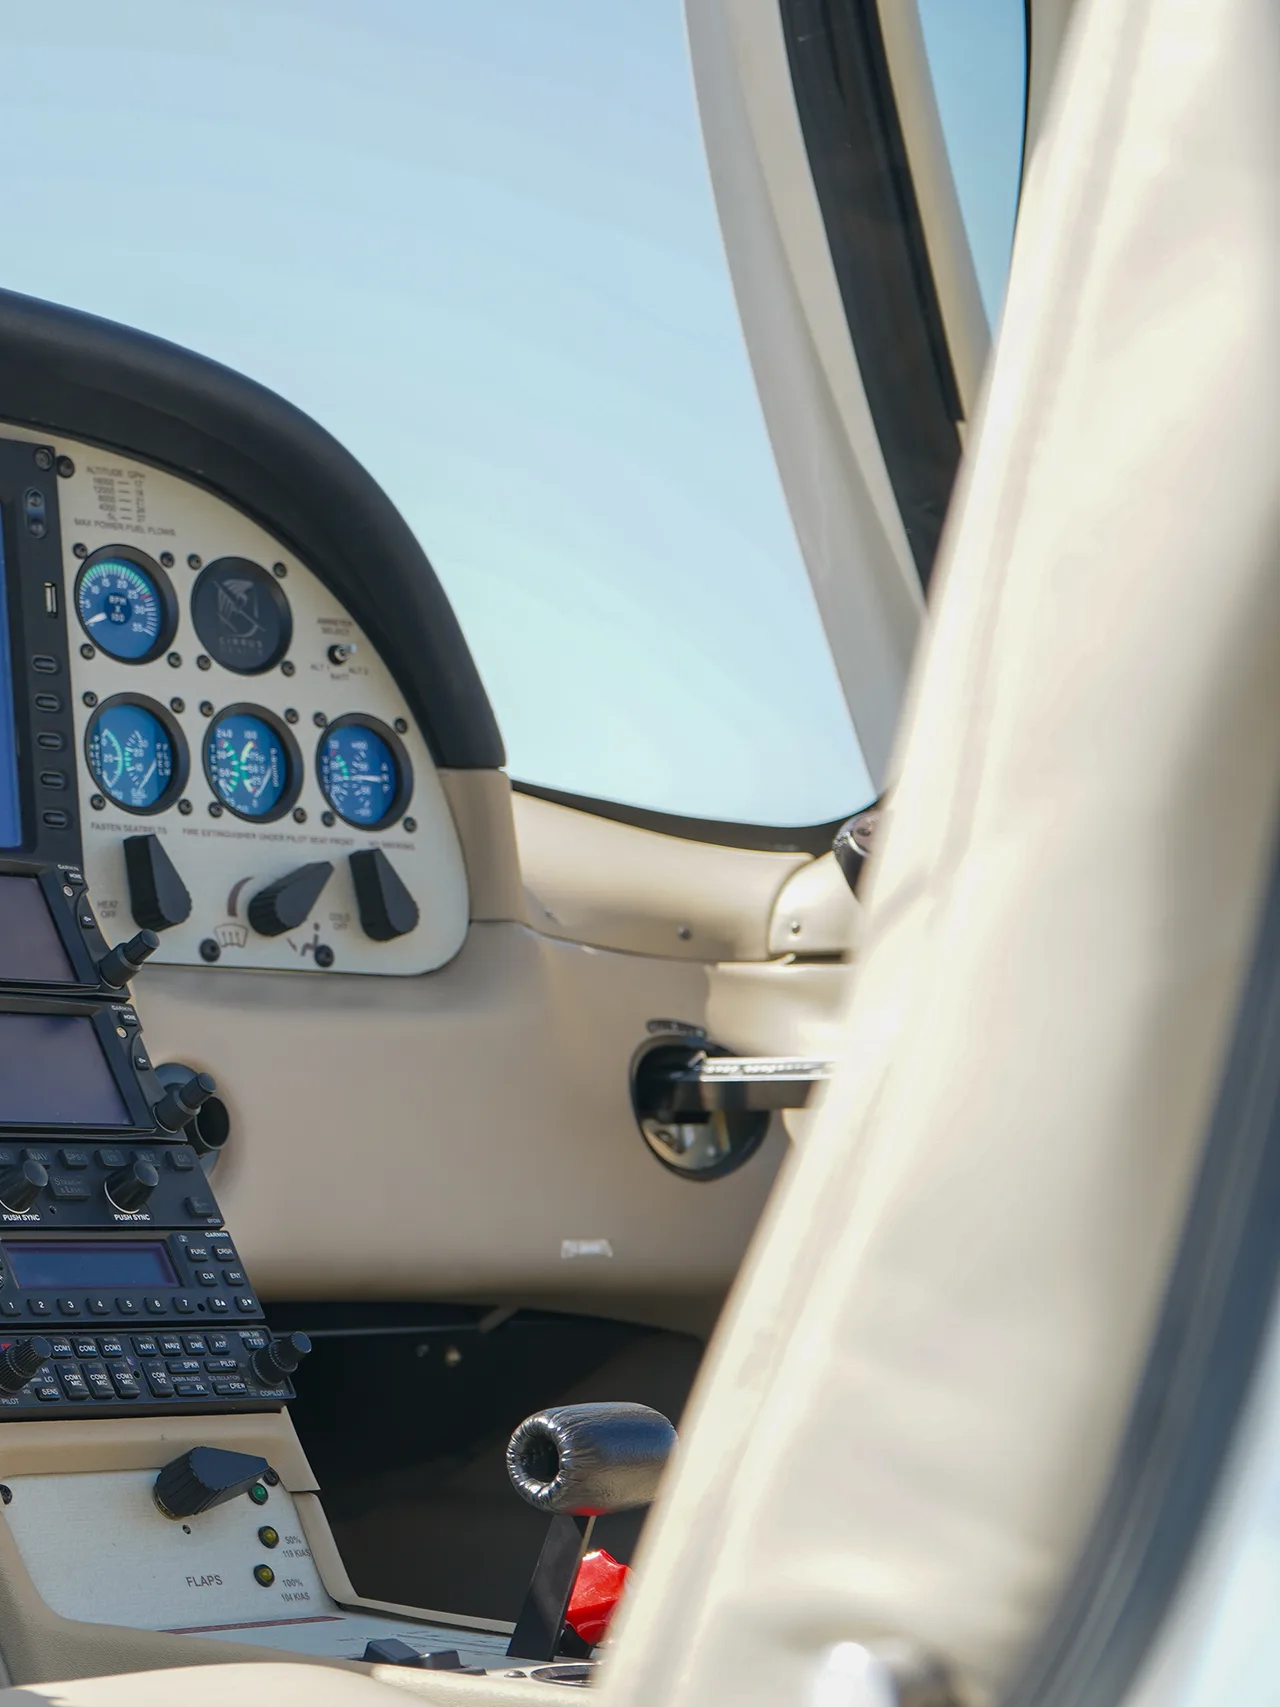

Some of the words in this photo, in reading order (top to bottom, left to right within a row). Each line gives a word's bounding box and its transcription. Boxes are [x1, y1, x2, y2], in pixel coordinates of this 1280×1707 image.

[94, 520, 124, 531] POWER
[126, 524, 145, 534] FUEL
[147, 526, 176, 537] FLOWS
[117, 579, 128, 589] 20
[127, 589, 138, 599] 25
[109, 595, 127, 605] RPM
[111, 612, 126, 622] 100
[90, 822, 121, 832] FASTEN
[123, 824, 167, 835] SEATBELTS
[182, 828, 199, 836] FIRE
[201, 829, 256, 840] EXTINGUISHER
[259, 832, 284, 841] UNDER
[286, 834, 307, 844] PILOT
[309, 836, 327, 845] SEAT
[329, 837, 355, 846] FRONT
[57, 864, 80, 872] GARMIN
[97, 900, 118, 909] HEAT
[100, 910, 116, 918] OFF
[111, 1004, 133, 1012] GARMIN
[202, 1272, 216, 1280] CLR
[229, 1272, 242, 1280] ENT
[248, 1338, 265, 1346] TEST
[284, 1536, 302, 1545] 50%
[282, 1550, 294, 1559] 119
[295, 1548, 311, 1557] KIAS
[185, 1574, 223, 1588] FLAPS
[282, 1579, 304, 1588] 100%
[281, 1593, 294, 1602] 104
[294, 1592, 311, 1601] KIAS
